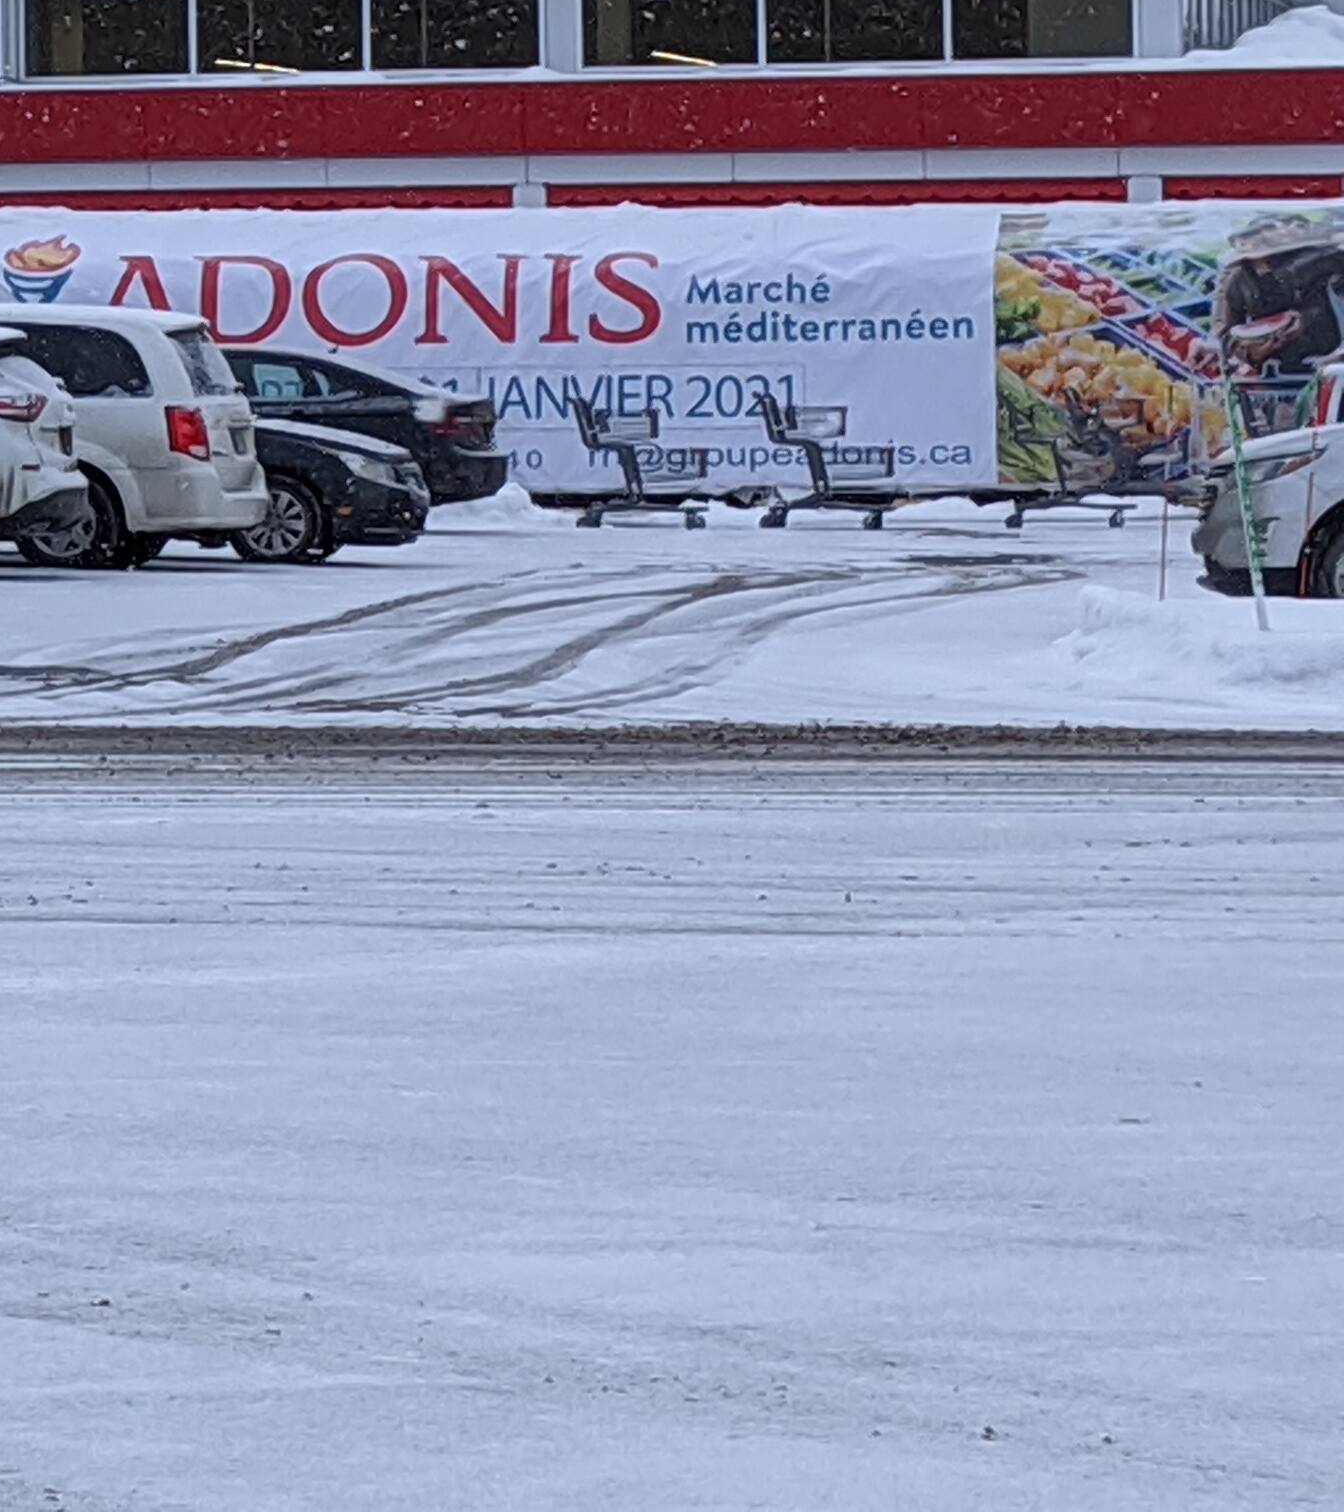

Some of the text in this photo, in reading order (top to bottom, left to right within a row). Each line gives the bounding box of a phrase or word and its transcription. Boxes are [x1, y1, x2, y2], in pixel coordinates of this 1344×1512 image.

[109, 251, 662, 347] ADONIS
[686, 273, 831, 304] Marché
[686, 309, 975, 344] méditerranéen
[686, 374, 794, 419] 2021
